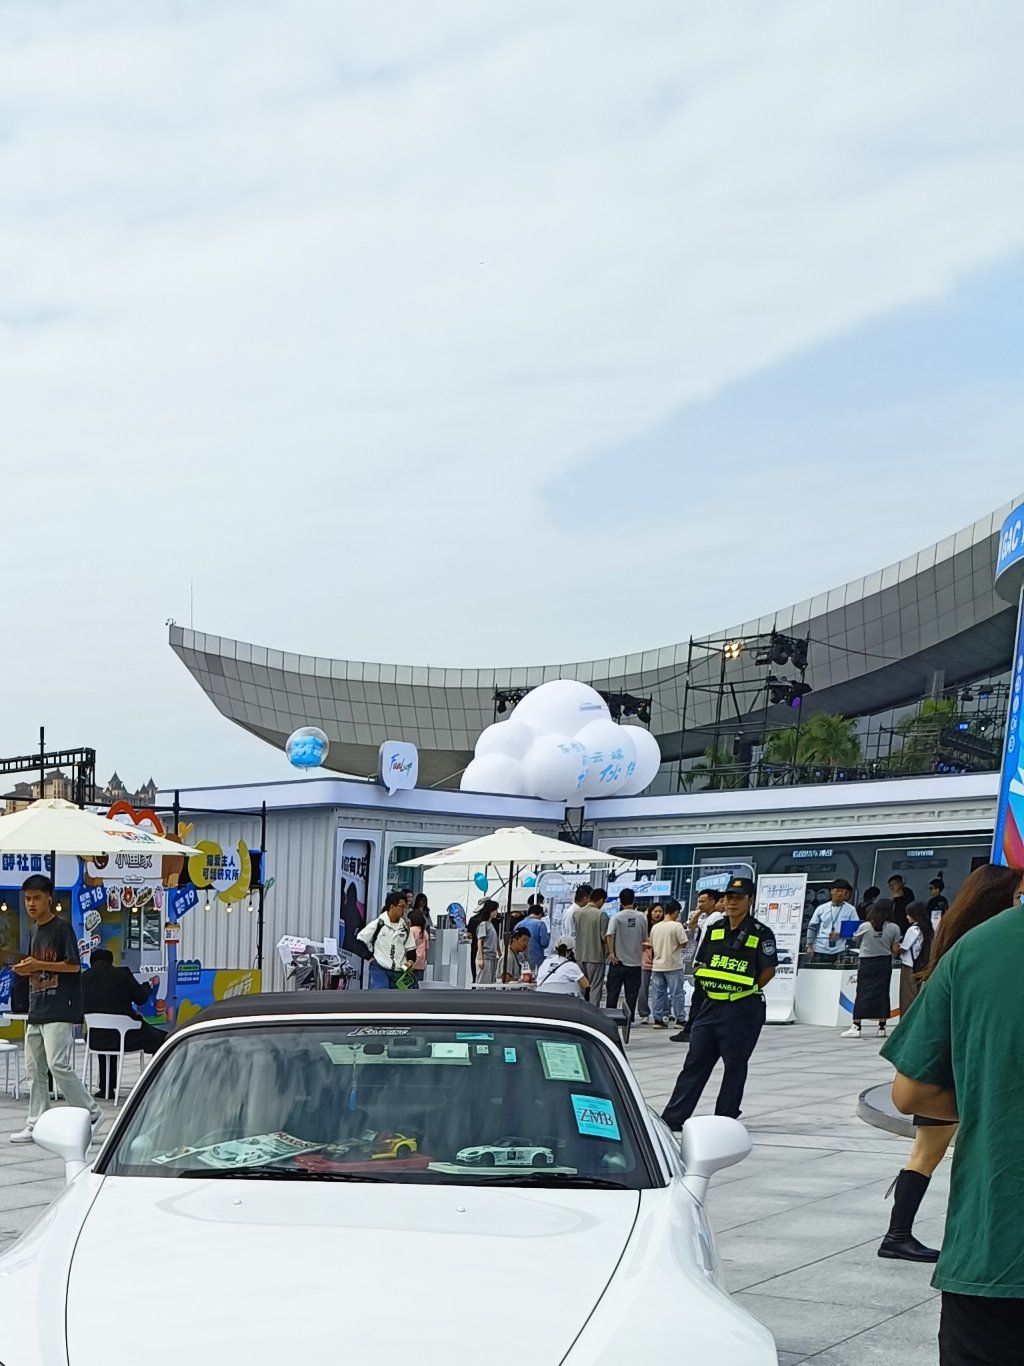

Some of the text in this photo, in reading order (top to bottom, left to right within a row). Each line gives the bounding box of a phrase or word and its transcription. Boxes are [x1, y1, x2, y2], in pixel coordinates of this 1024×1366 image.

[91, 886, 104, 903] 18
[710, 954, 748, 973] 番禺安保
